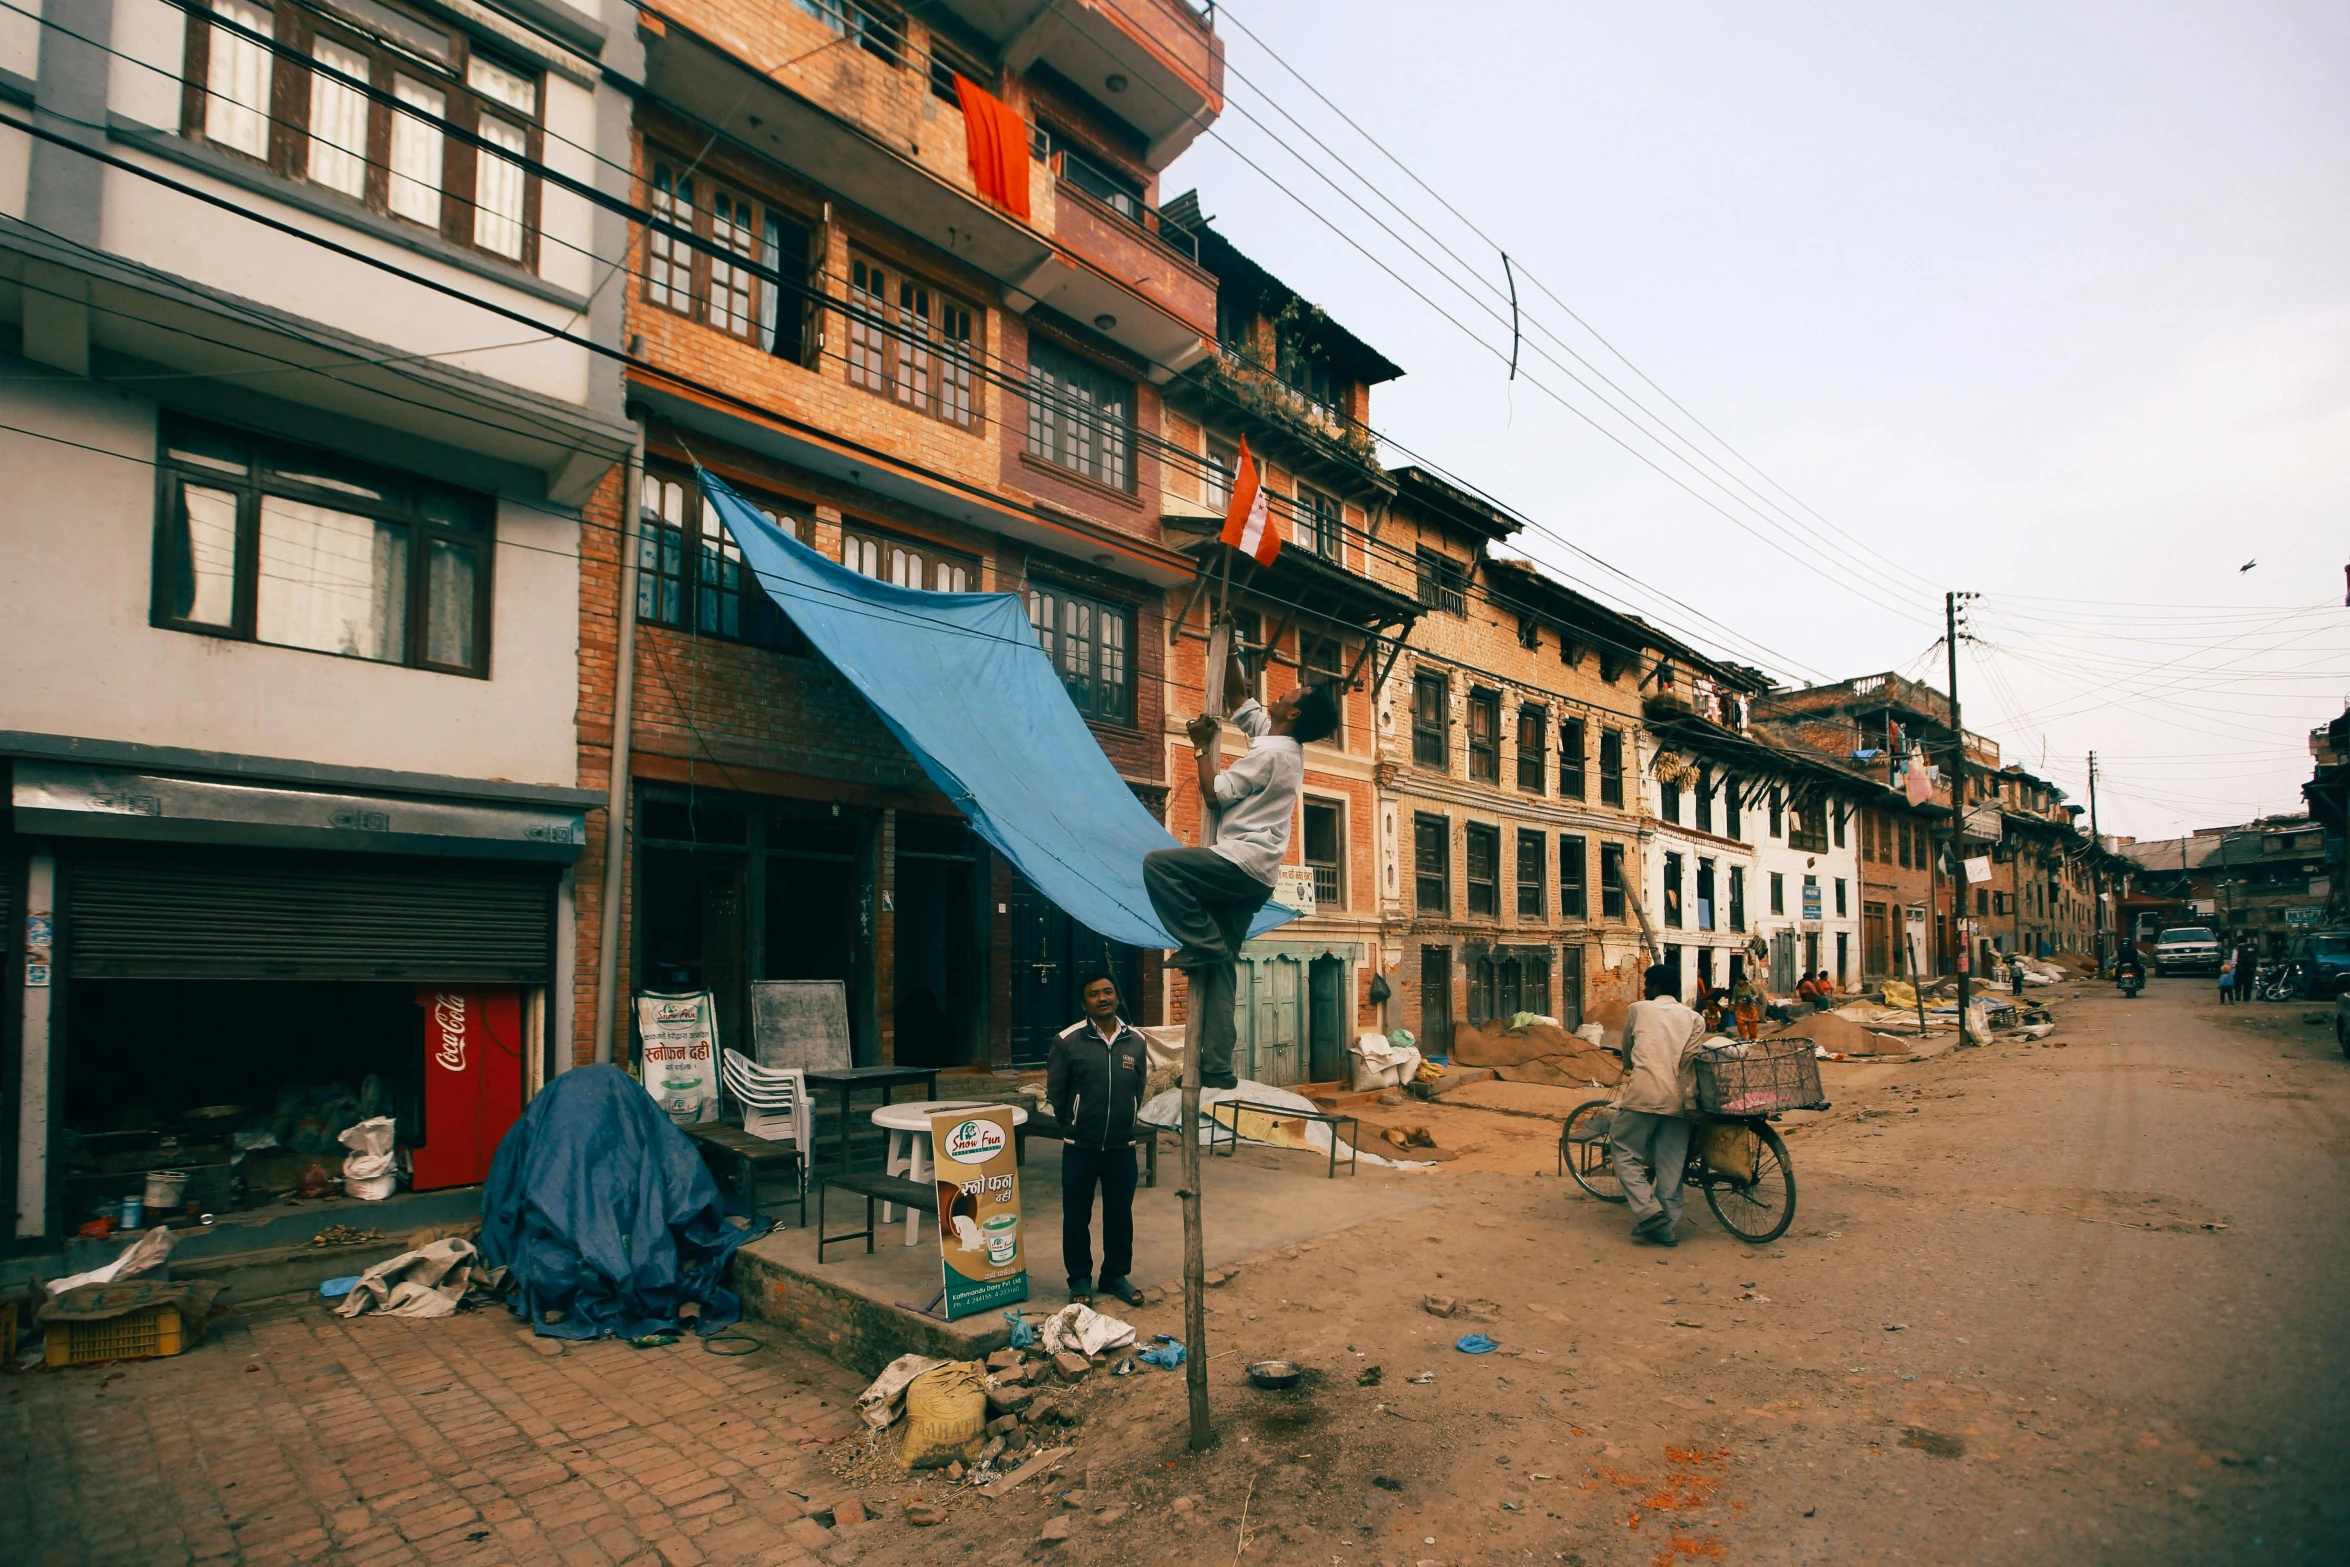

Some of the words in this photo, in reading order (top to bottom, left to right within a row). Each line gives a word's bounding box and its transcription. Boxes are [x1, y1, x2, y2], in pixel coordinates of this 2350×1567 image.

[435, 993, 466, 1071] Coca-Cola
[644, 1042, 686, 1063] स्नोफन
[689, 1041, 710, 1060] दही
[952, 1134, 978, 1151] Snow
[982, 1130, 1001, 1148] Fun
[961, 1173, 986, 1196] स्नो
[988, 1174, 1013, 1191] फन
[952, 1287, 986, 1300] Kathmandu
[986, 1284, 1001, 1292] Dairy
[917, 1418, 978, 1440] AARATI
